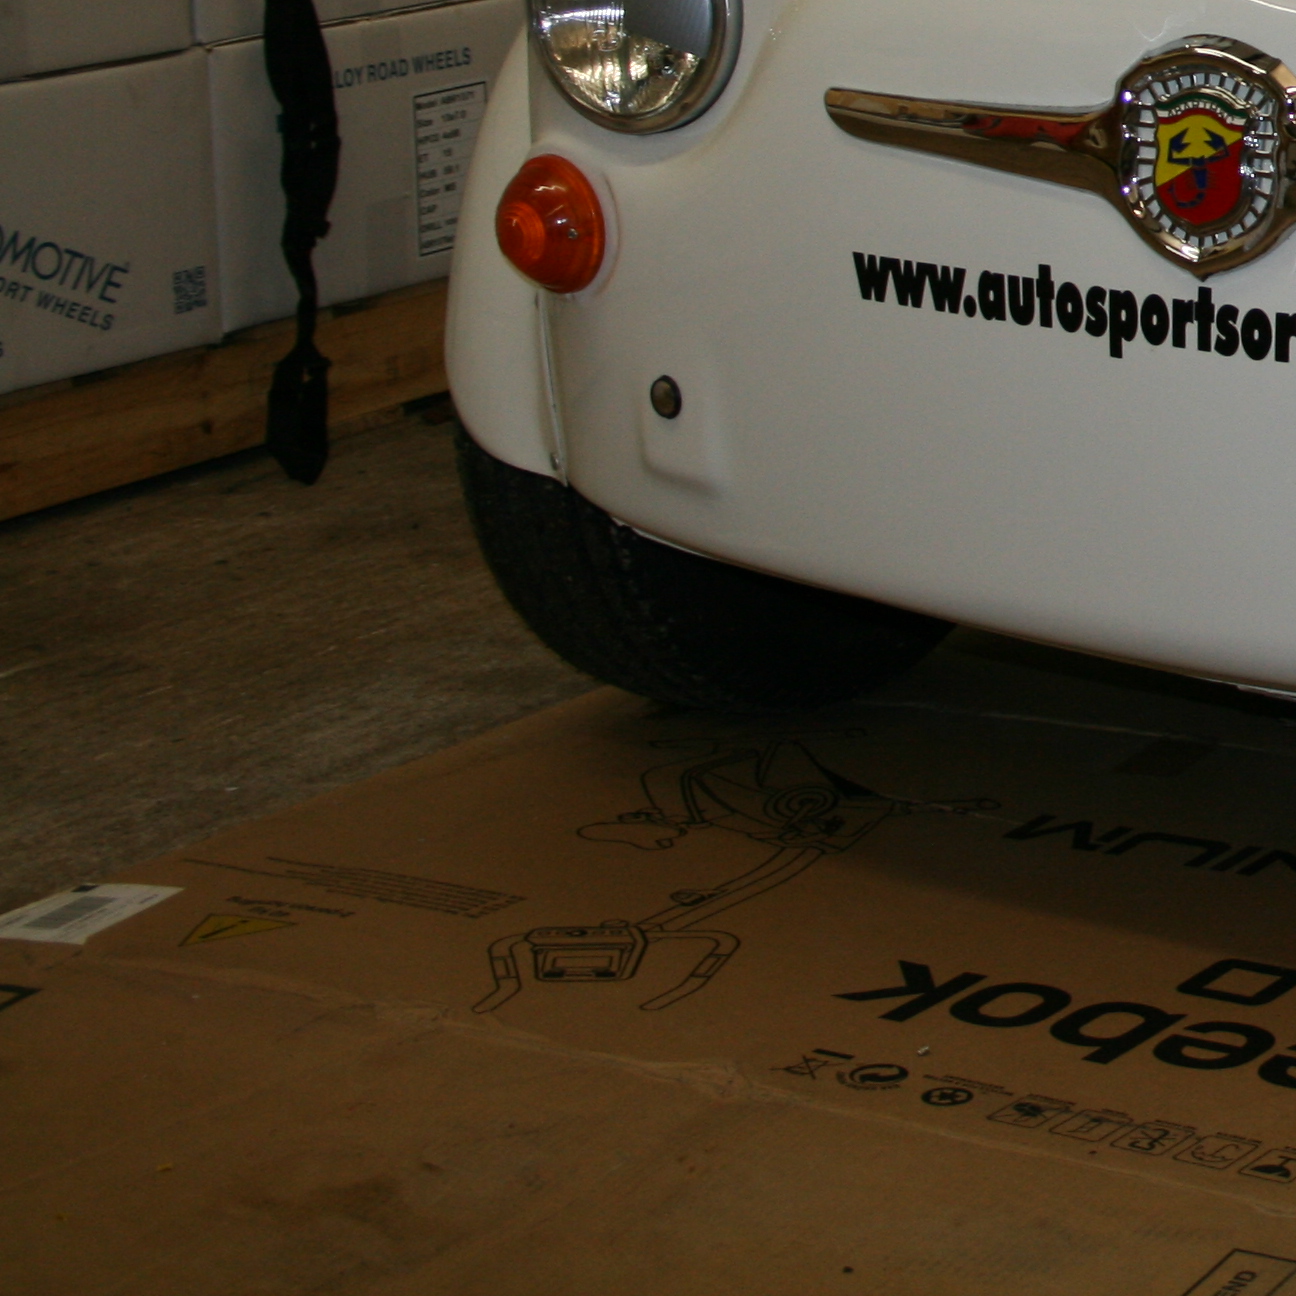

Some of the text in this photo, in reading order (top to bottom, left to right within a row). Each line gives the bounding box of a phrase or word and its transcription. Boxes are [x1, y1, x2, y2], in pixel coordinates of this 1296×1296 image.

[367, 57, 409, 82] ROAD
[411, 47, 472, 75] WHEELS
[36, 290, 116, 331] WHEELS
